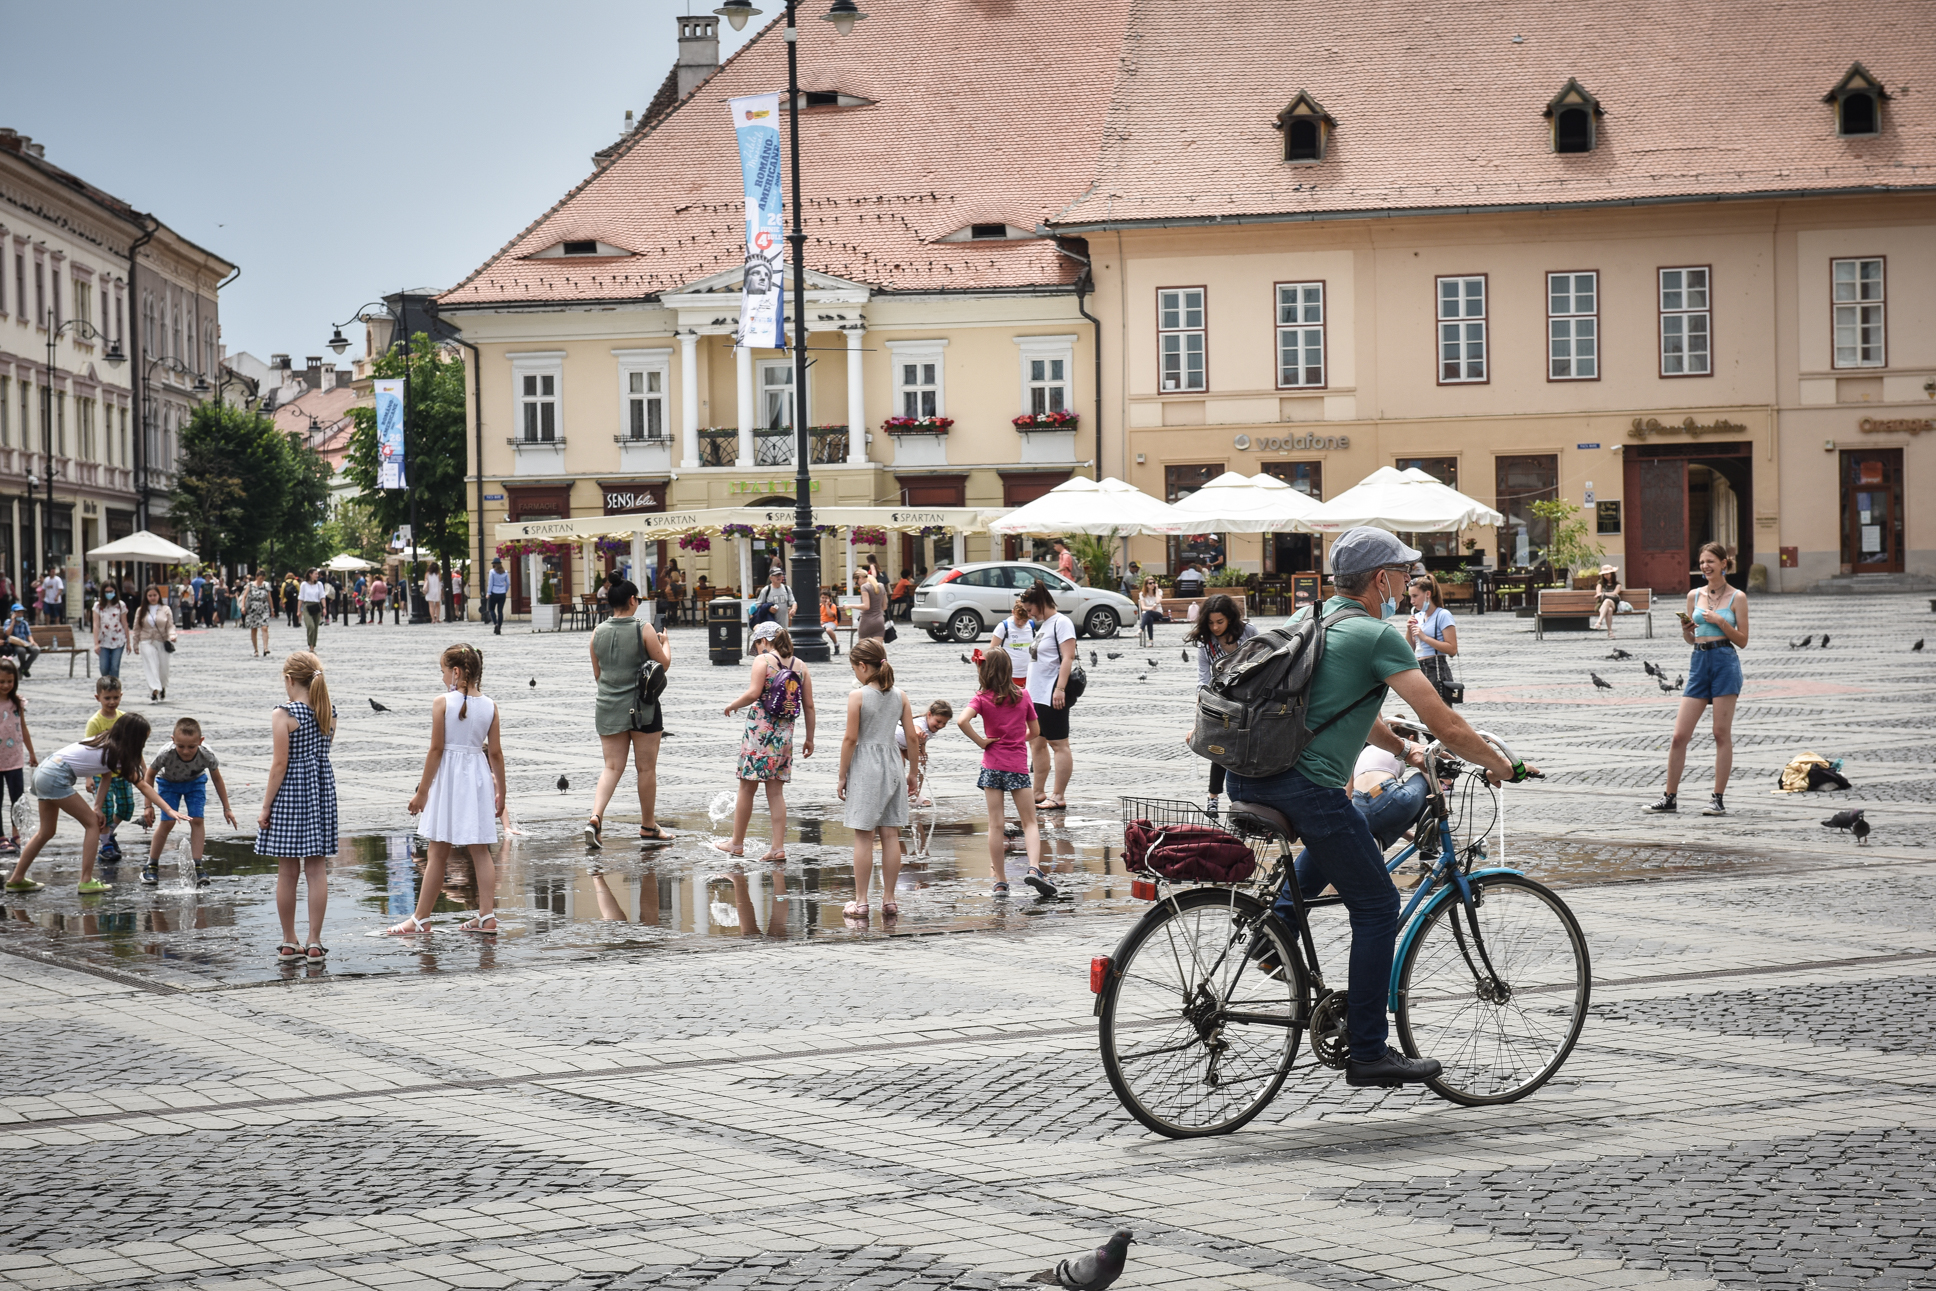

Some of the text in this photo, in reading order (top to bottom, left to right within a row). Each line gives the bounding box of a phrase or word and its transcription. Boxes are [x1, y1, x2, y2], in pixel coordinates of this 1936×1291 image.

[754, 135, 773, 188] ROMÂNO-
[767, 213, 783, 226] 26
[757, 234, 768, 247] 4
[1859, 416, 1933, 436] Orange
[389, 433, 402, 442] 26
[1256, 432, 1351, 450] vodafone
[729, 481, 819, 493] SPARTN
[607, 493, 634, 508] SENSI
[653, 514, 696, 526] SPARTAN
[775, 512, 818, 521] SPARN
[900, 513, 944, 523] SPARTAN
[531, 523, 574, 535] SPARTAN
